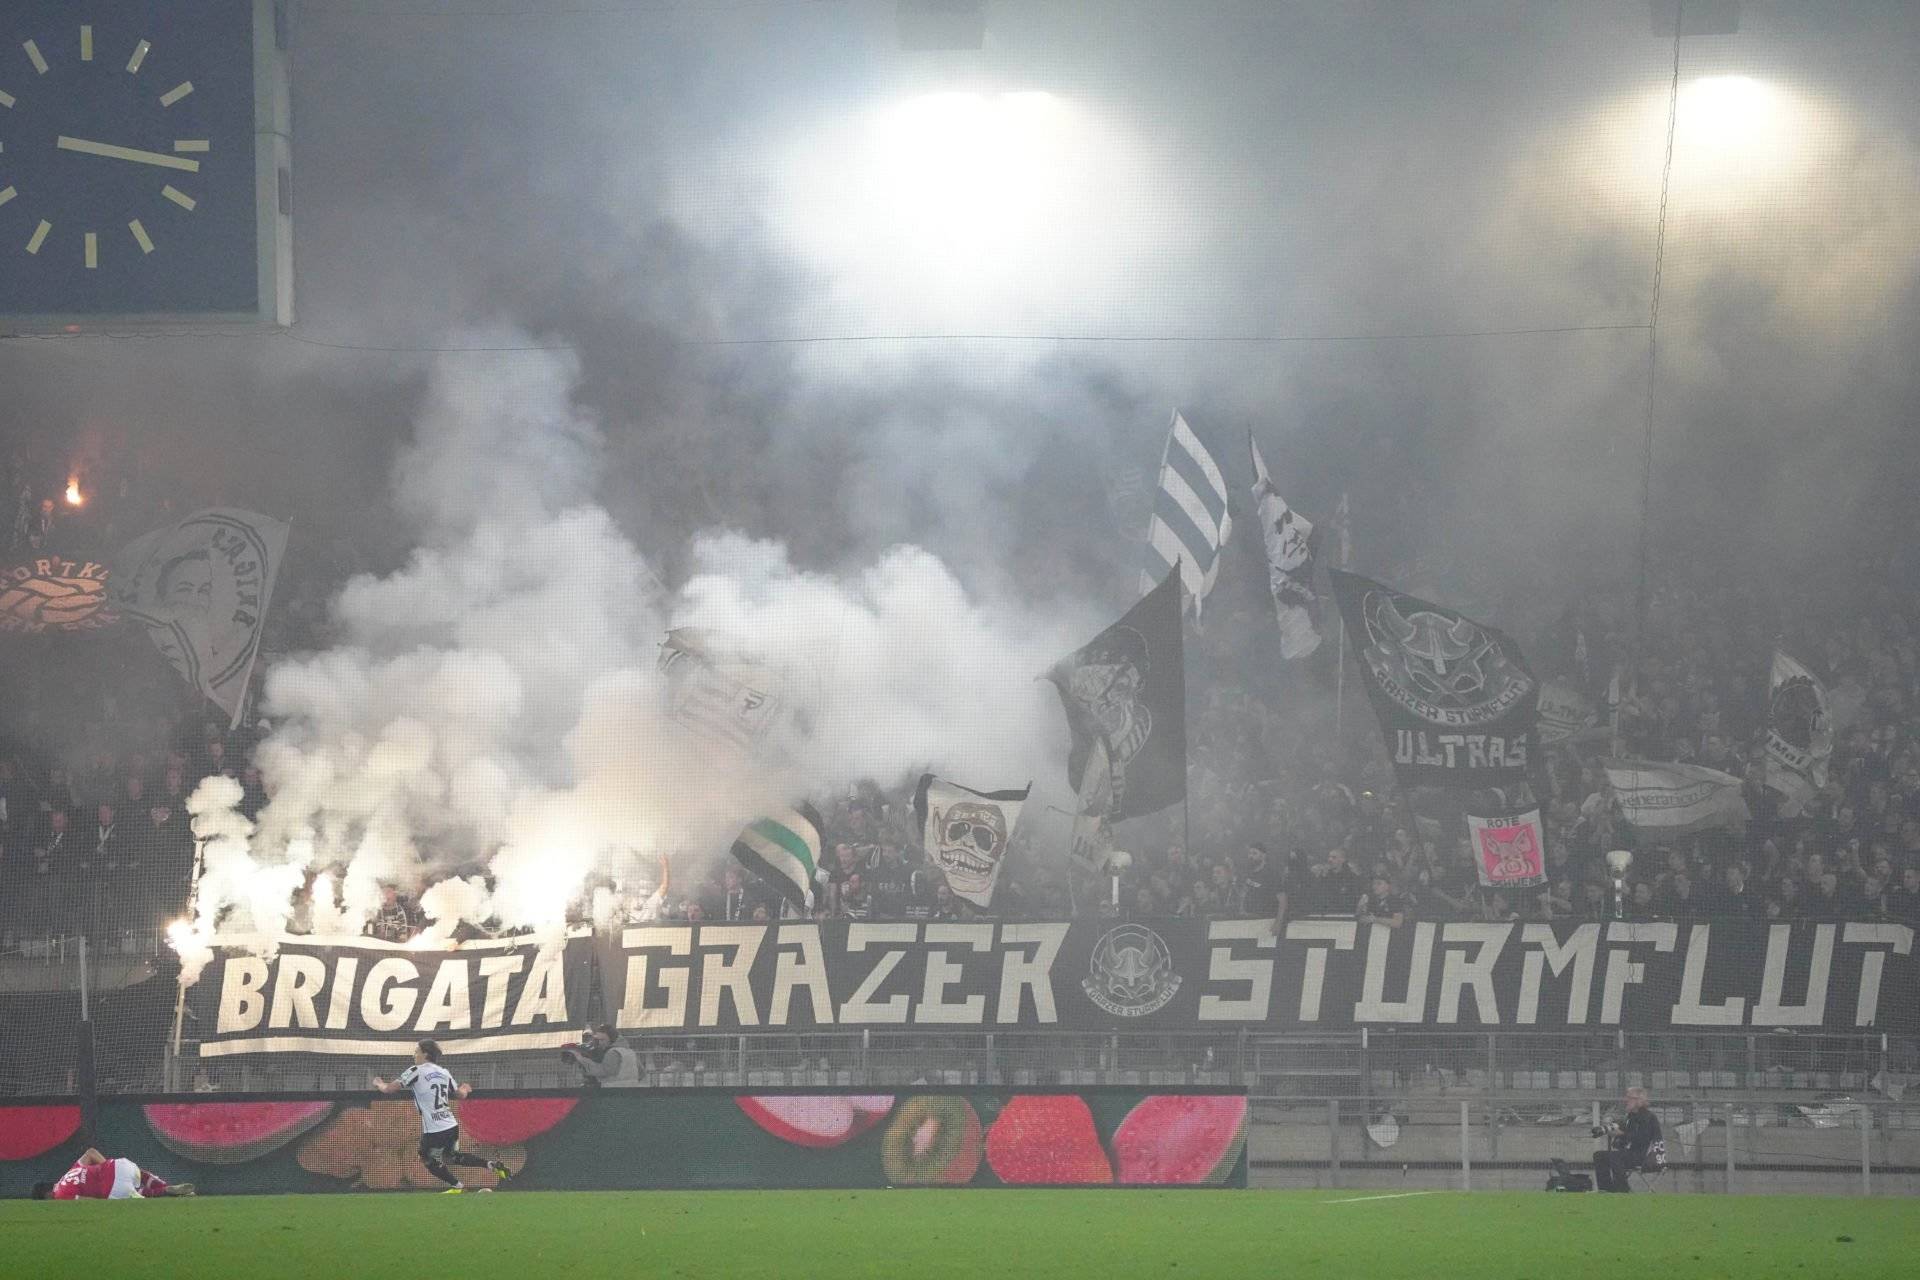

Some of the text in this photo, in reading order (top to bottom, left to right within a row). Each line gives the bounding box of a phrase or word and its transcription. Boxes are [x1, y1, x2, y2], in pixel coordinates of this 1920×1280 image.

[1394, 728, 1528, 769] ULTRAS
[1486, 816, 1520, 829] ROTE
[217, 948, 569, 1034] BRIGATA
[615, 918, 1915, 1029] GRAZER STURMFLUT
[431, 1083, 448, 1110] 25
